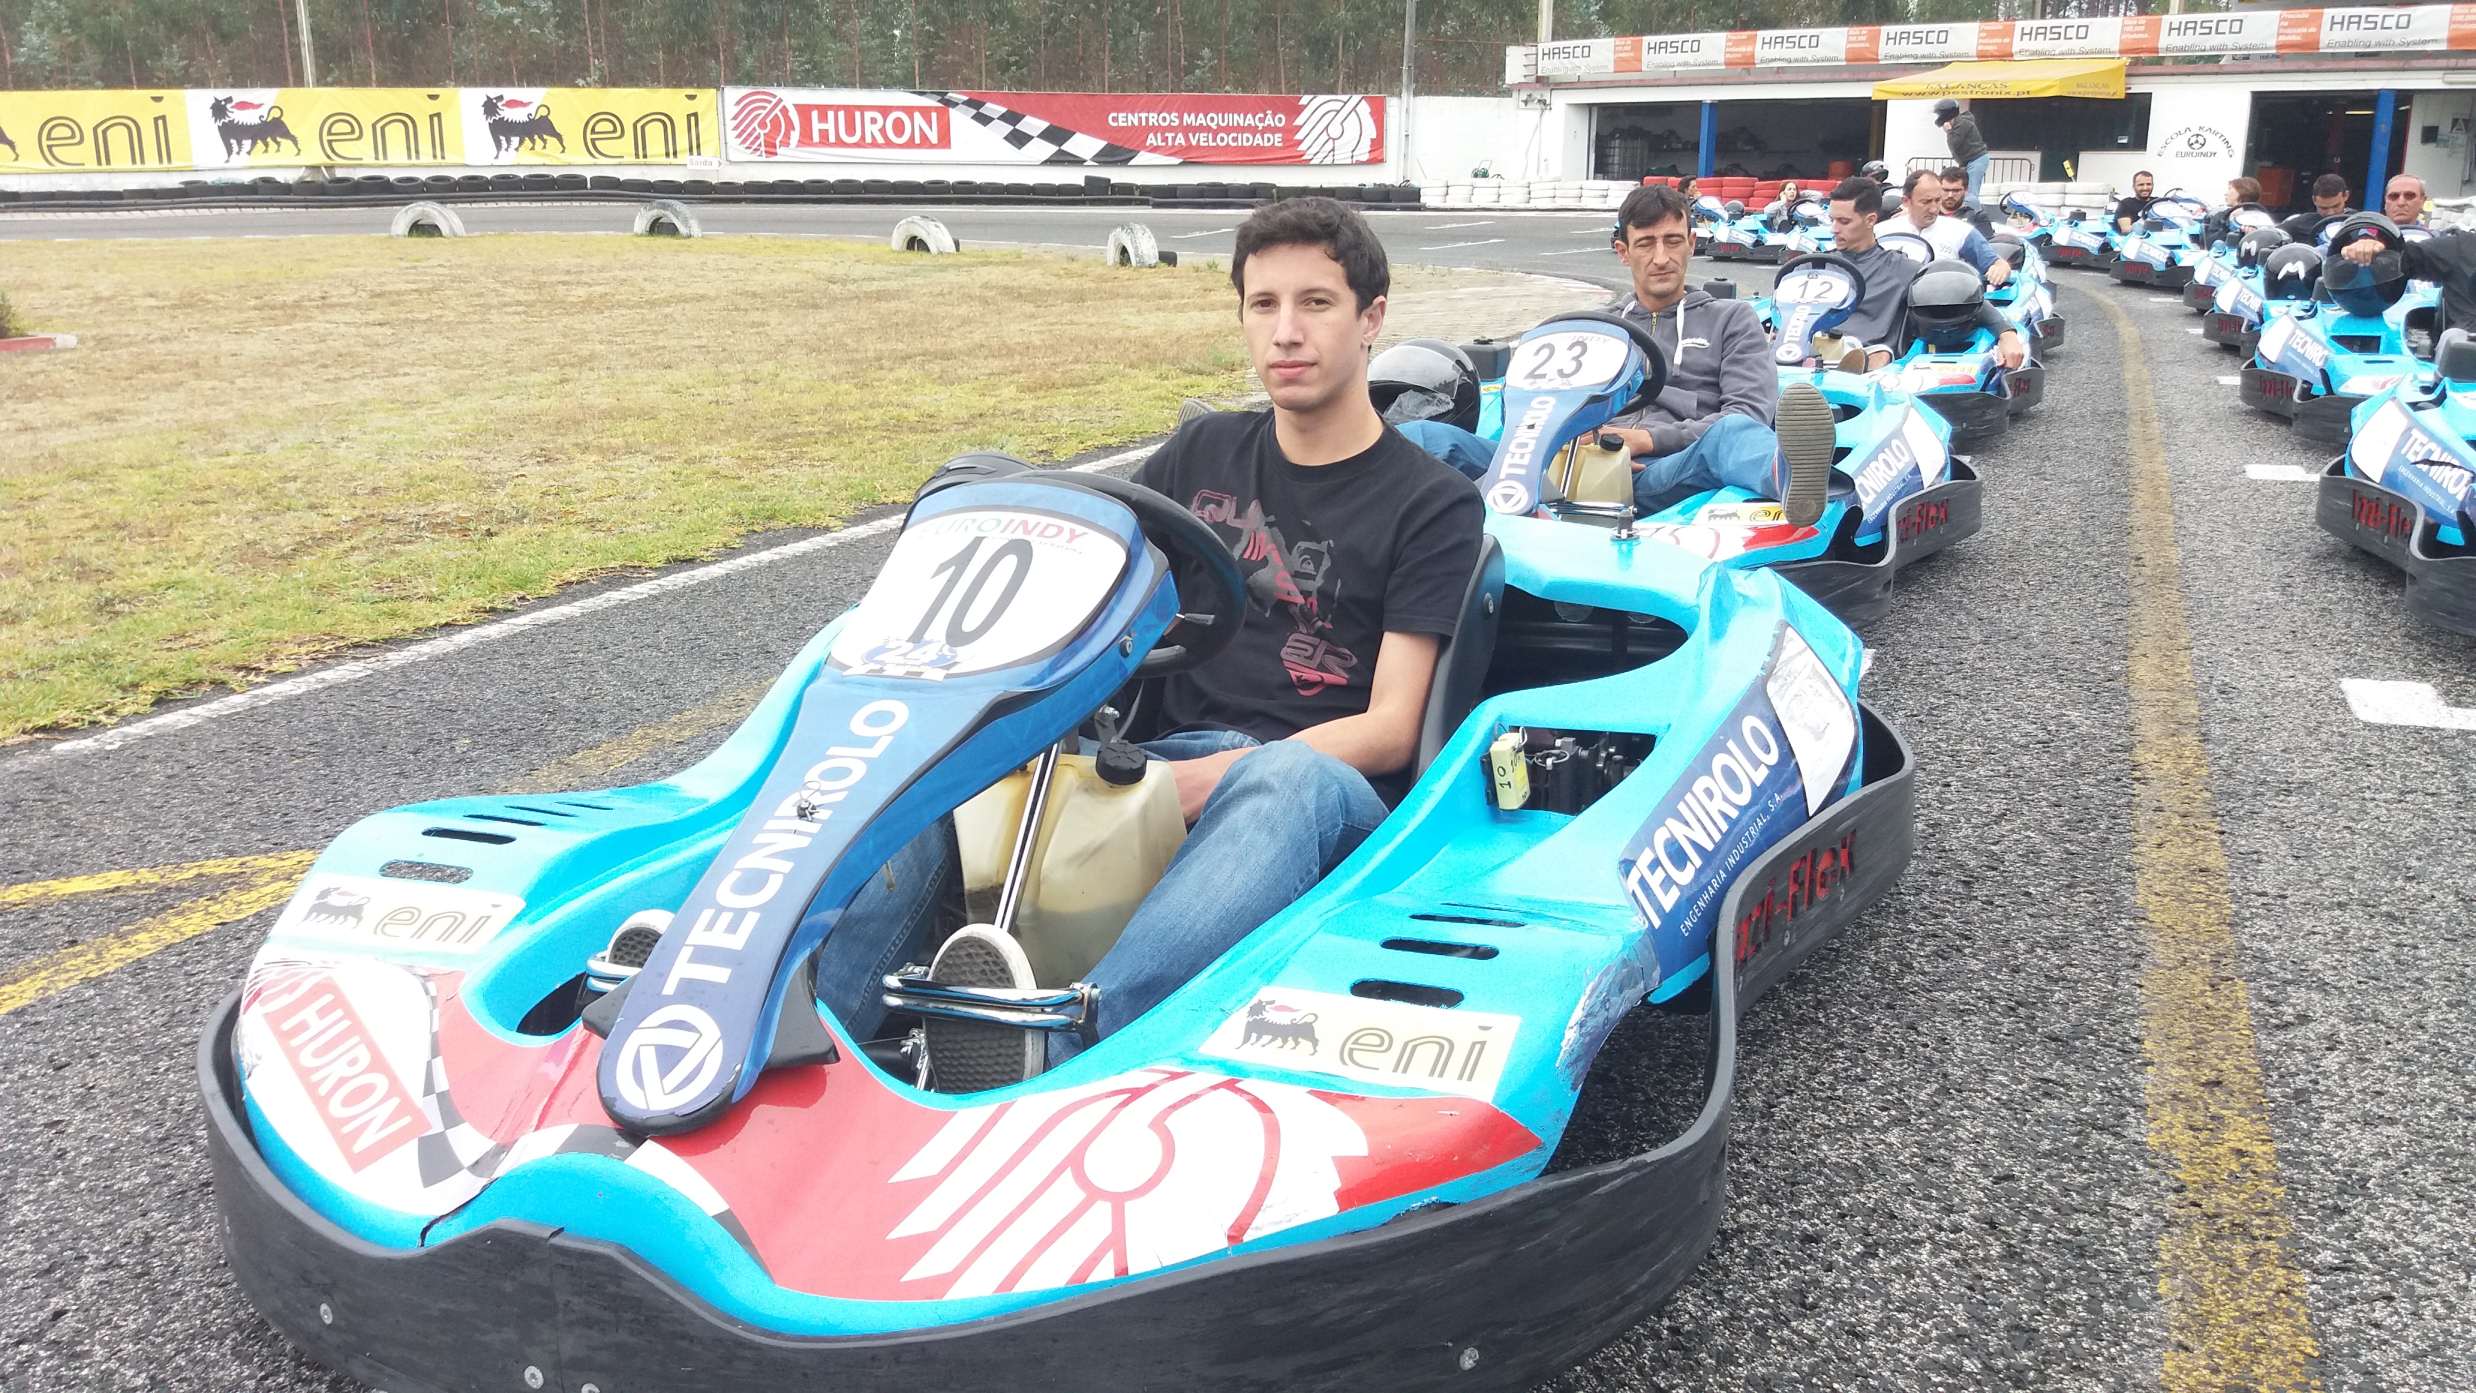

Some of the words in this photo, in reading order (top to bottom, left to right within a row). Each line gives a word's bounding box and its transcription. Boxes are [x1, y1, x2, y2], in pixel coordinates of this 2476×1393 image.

[1885, 29, 1949, 46] HASCO
[2019, 24, 2090, 42] HASCO
[2167, 18, 2244, 37] HASCO
[2329, 13, 2412, 31] HASCO
[1542, 44, 1591, 61] HASCO
[1647, 39, 1701, 55] HASCO
[1760, 34, 1820, 50] HASCO
[37, 95, 171, 167] eni
[318, 93, 447, 162] eni
[582, 93, 701, 161] eni
[811, 107, 940, 146] HURON
[1107, 112, 1180, 127] CENTROS
[1183, 110, 1286, 130] MAQUINAÇÃO
[1146, 132, 1187, 147] ALTA
[1189, 132, 1283, 147] VELOCIDADE
[1798, 280, 1833, 299] 12
[1523, 341, 1588, 380] 23
[930, 536, 1034, 649] 10
[1496, 765, 1512, 790] 10
[1627, 714, 1780, 930] TECNIROLO
[662, 699, 910, 996] TECNIROLO
[1679, 869, 1727, 937] ENGENHARIA
[1725, 812, 1770, 872] INDUSTRIAL,
[1768, 793, 1783, 813] S.A.
[373, 903, 503, 944] eni
[1339, 1025, 1494, 1082] eni
[279, 992, 412, 1155] HURON
